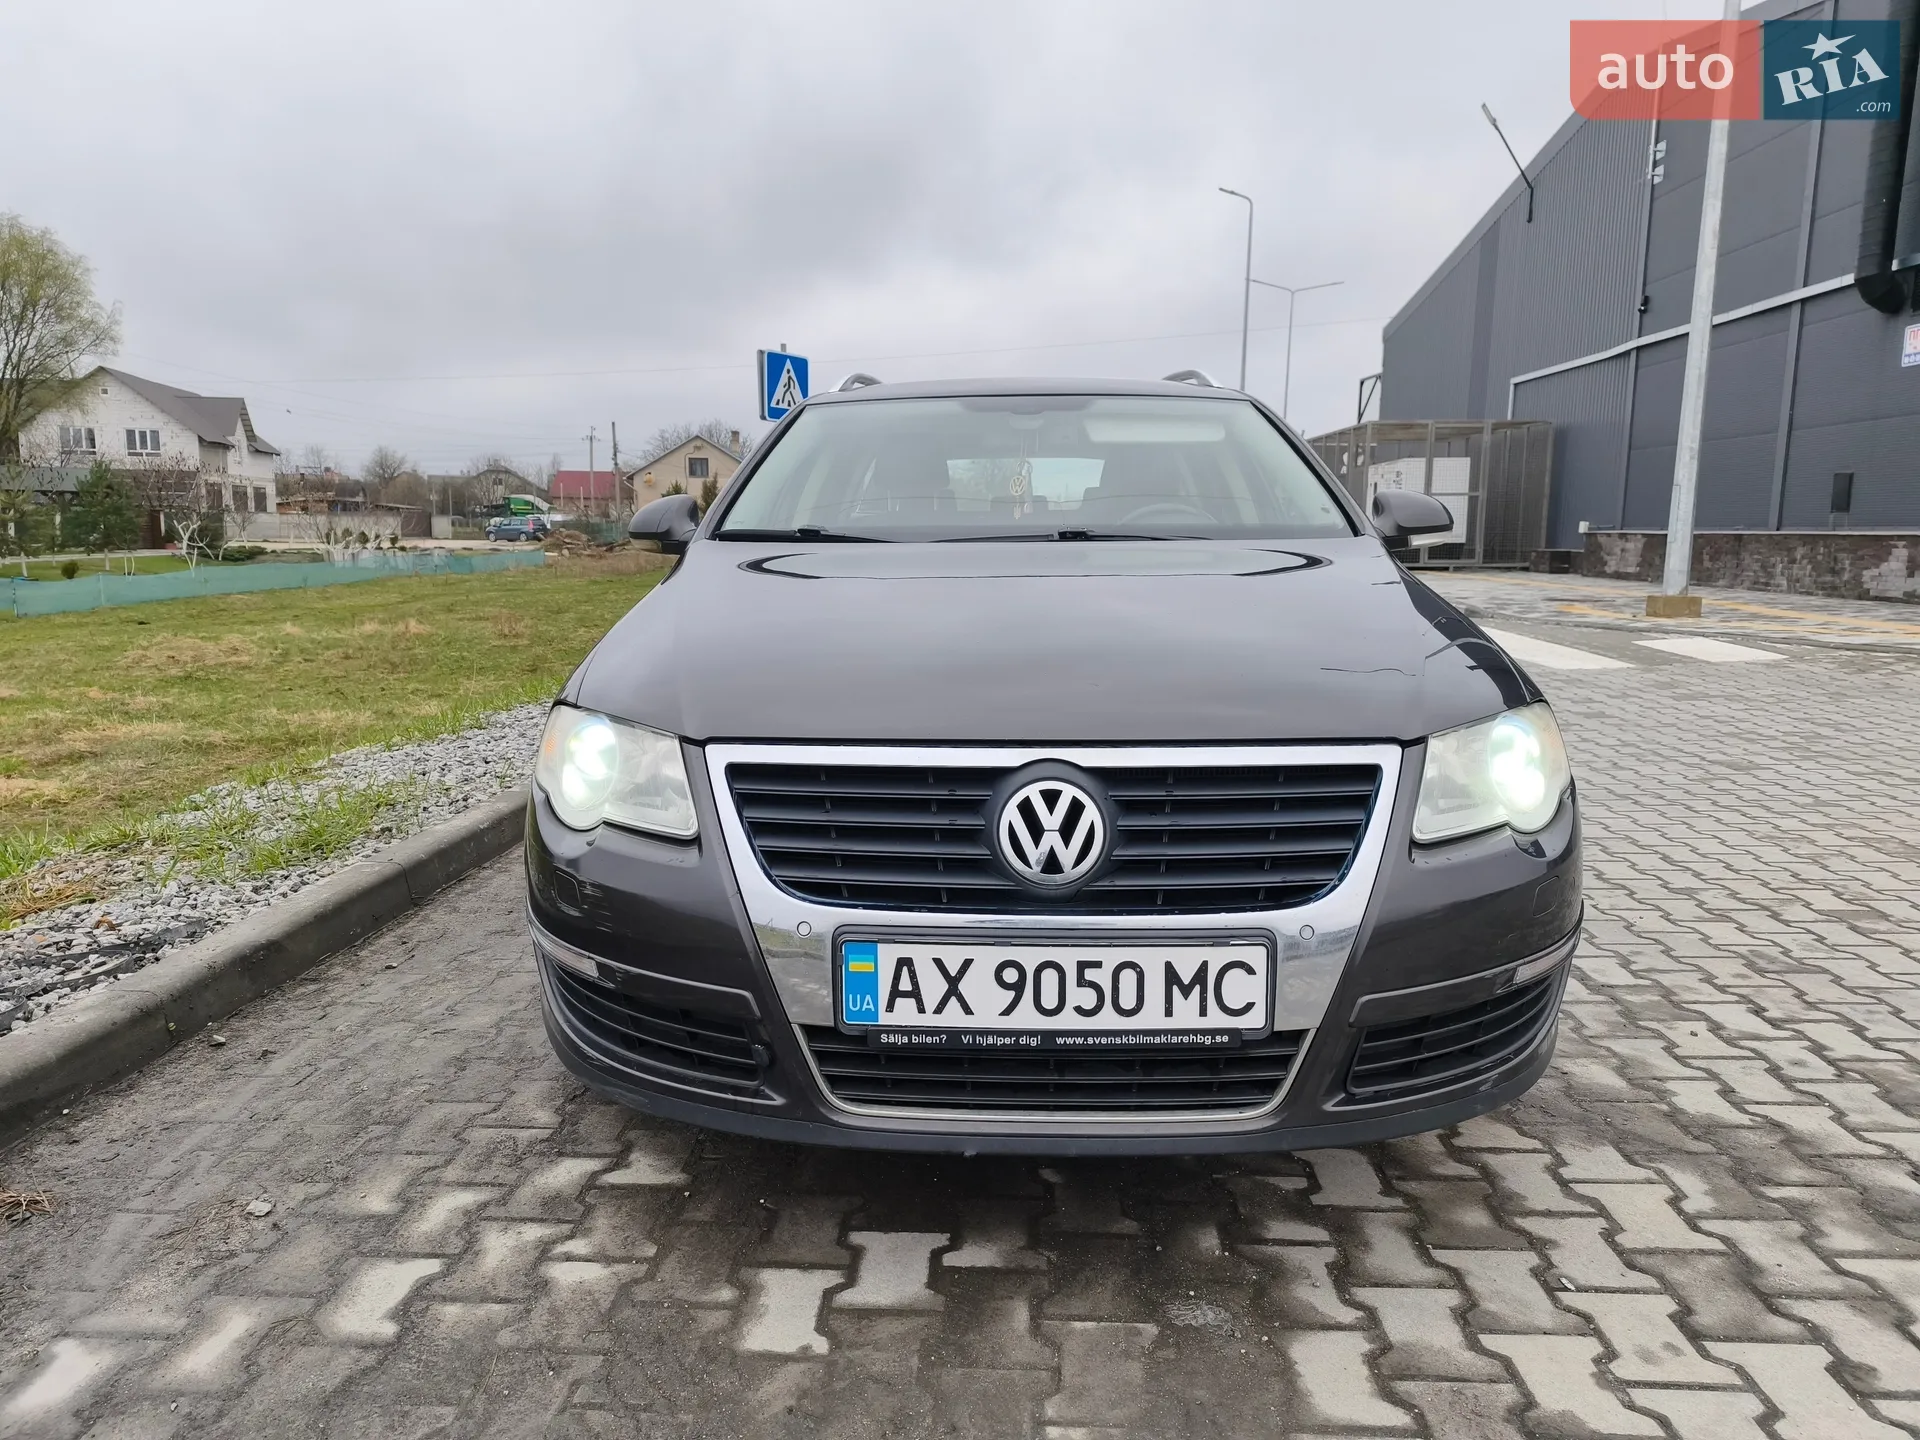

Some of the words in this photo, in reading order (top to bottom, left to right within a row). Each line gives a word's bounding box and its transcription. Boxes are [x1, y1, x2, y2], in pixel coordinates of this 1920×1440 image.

[884, 956, 975, 1016] AX
[993, 959, 1145, 1018] 9050
[1164, 959, 1257, 1018] MC
[848, 993, 876, 1012] UA
[880, 1033, 909, 1045] Sälja
[911, 1033, 947, 1044] bilen?
[961, 1034, 973, 1044] Vi
[976, 1034, 1016, 1046] hjälper
[1019, 1034, 1041, 1046] dig!
[1055, 1033, 1229, 1045] www.svenskbilmaklarehbg.se
